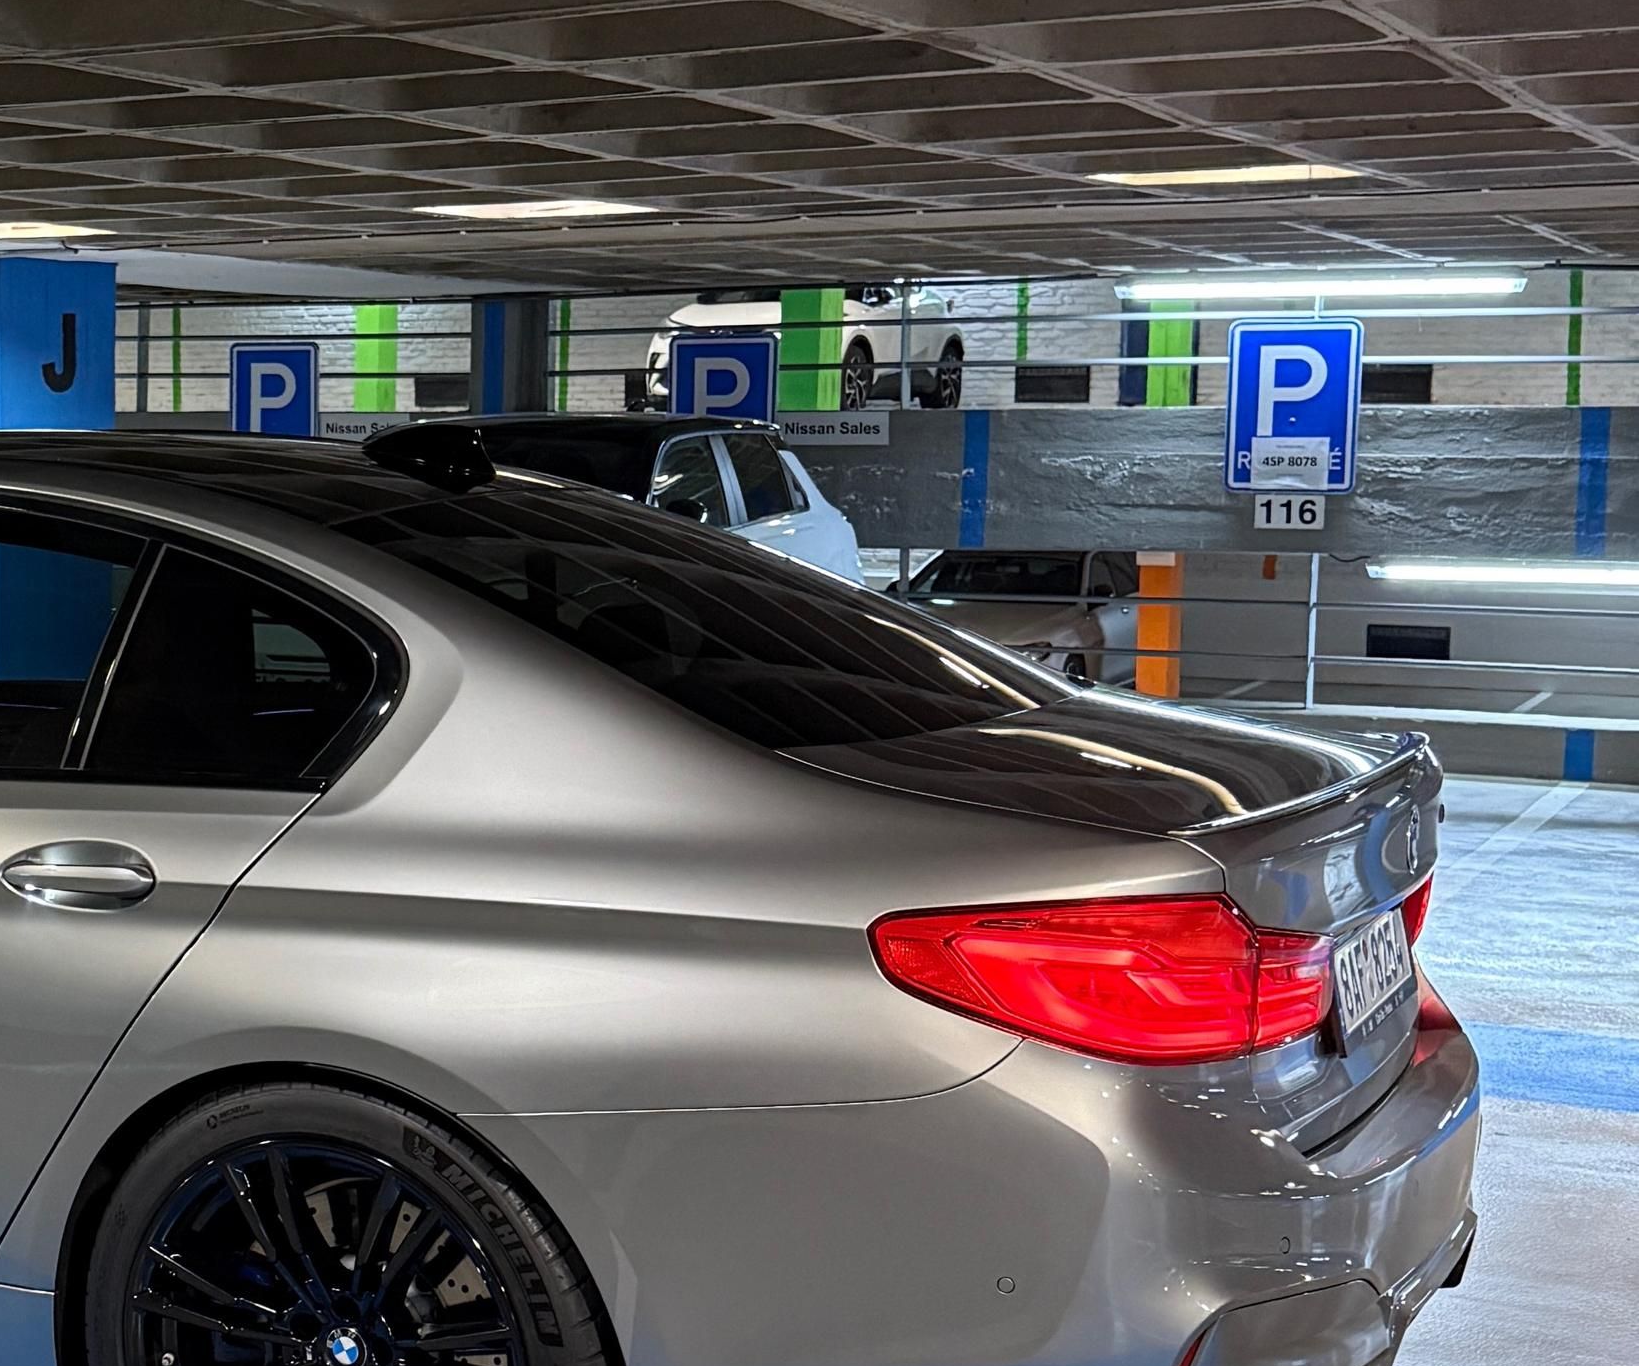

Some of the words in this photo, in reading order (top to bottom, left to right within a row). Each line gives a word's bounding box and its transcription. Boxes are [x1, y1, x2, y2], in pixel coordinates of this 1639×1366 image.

[42, 313, 77, 393] J
[249, 362, 297, 433] P
[693, 356, 751, 418] P
[1257, 344, 1328, 437] P
[325, 422, 367, 435] Nissan
[784, 422, 835, 435] Nissan
[839, 421, 880, 435] Sales
[1287, 455, 1318, 468] 8078
[1259, 499, 1317, 525] 116
[440, 1163, 562, 1337] MICHELIN
